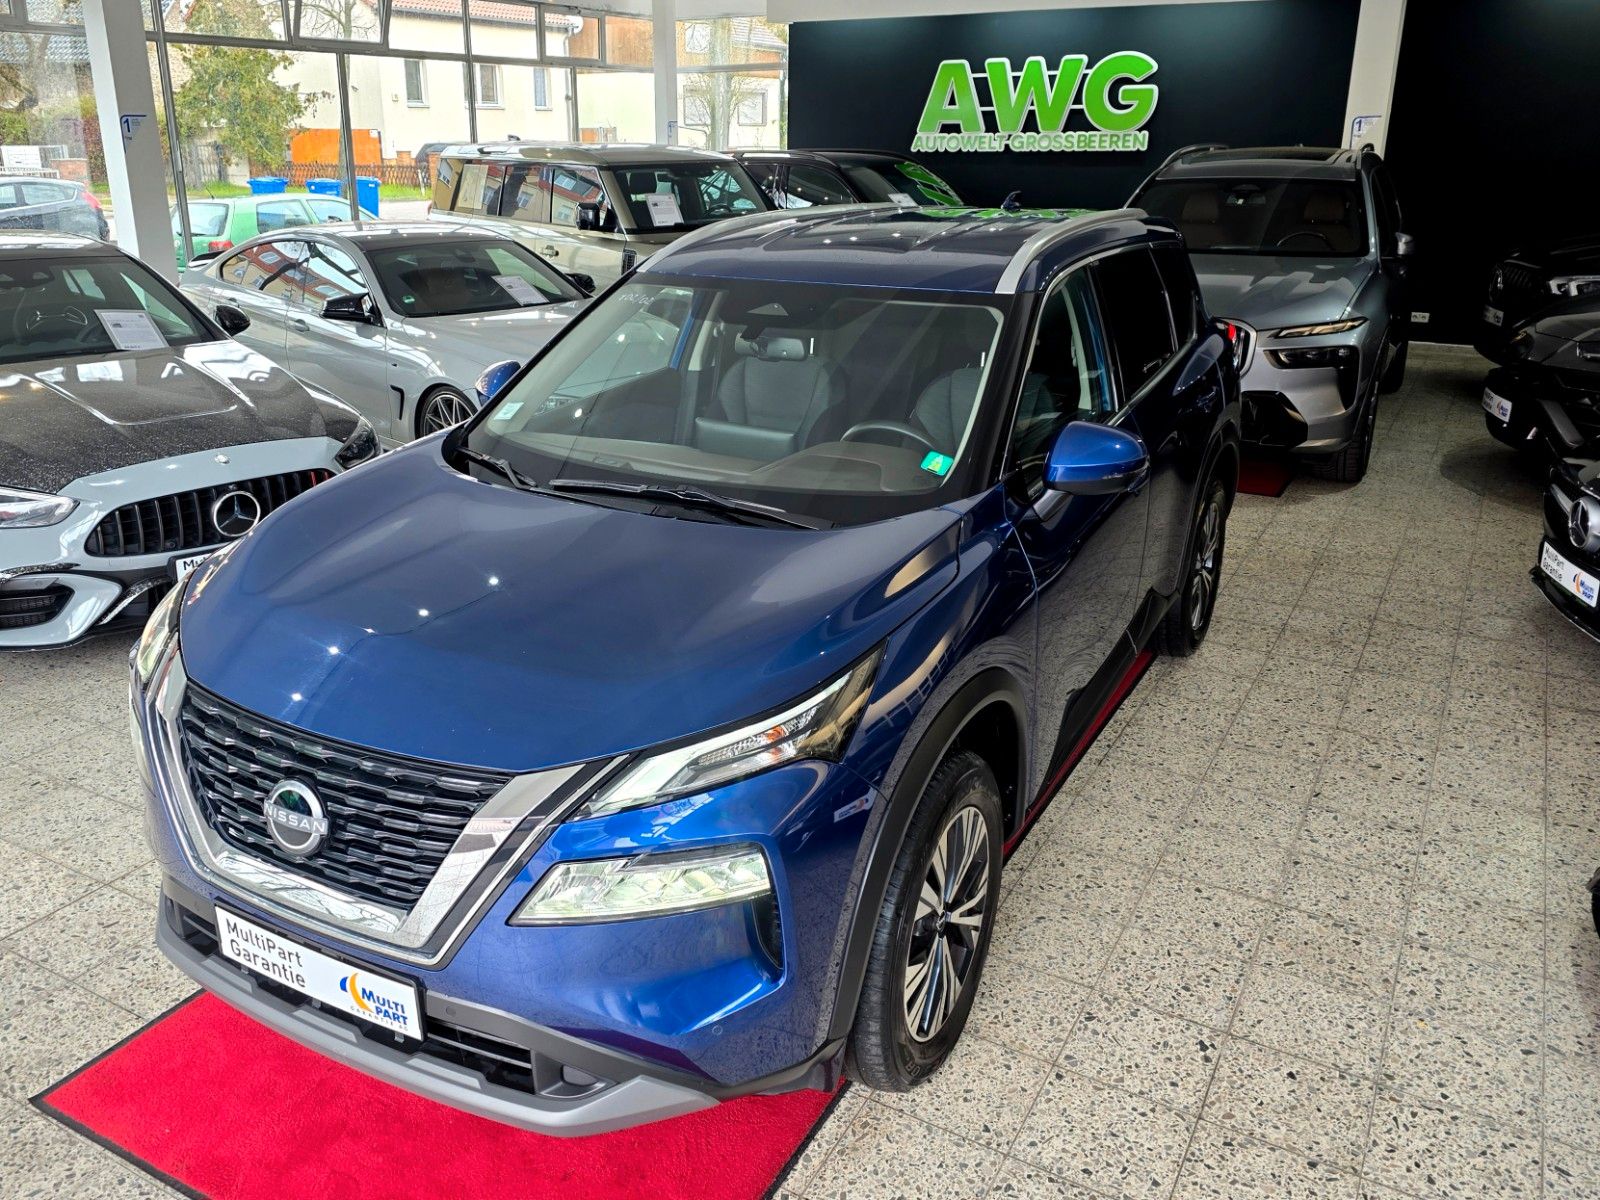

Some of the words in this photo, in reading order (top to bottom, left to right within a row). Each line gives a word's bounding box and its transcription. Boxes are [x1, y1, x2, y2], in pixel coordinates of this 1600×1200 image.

[917, 51, 1158, 133] AWG
[263, 800, 326, 833] NISSAN
[226, 918, 303, 968] MultiPart
[230, 938, 306, 988] Garantie
[361, 986, 405, 1014] MULTI
[374, 1005, 408, 1026] PART
